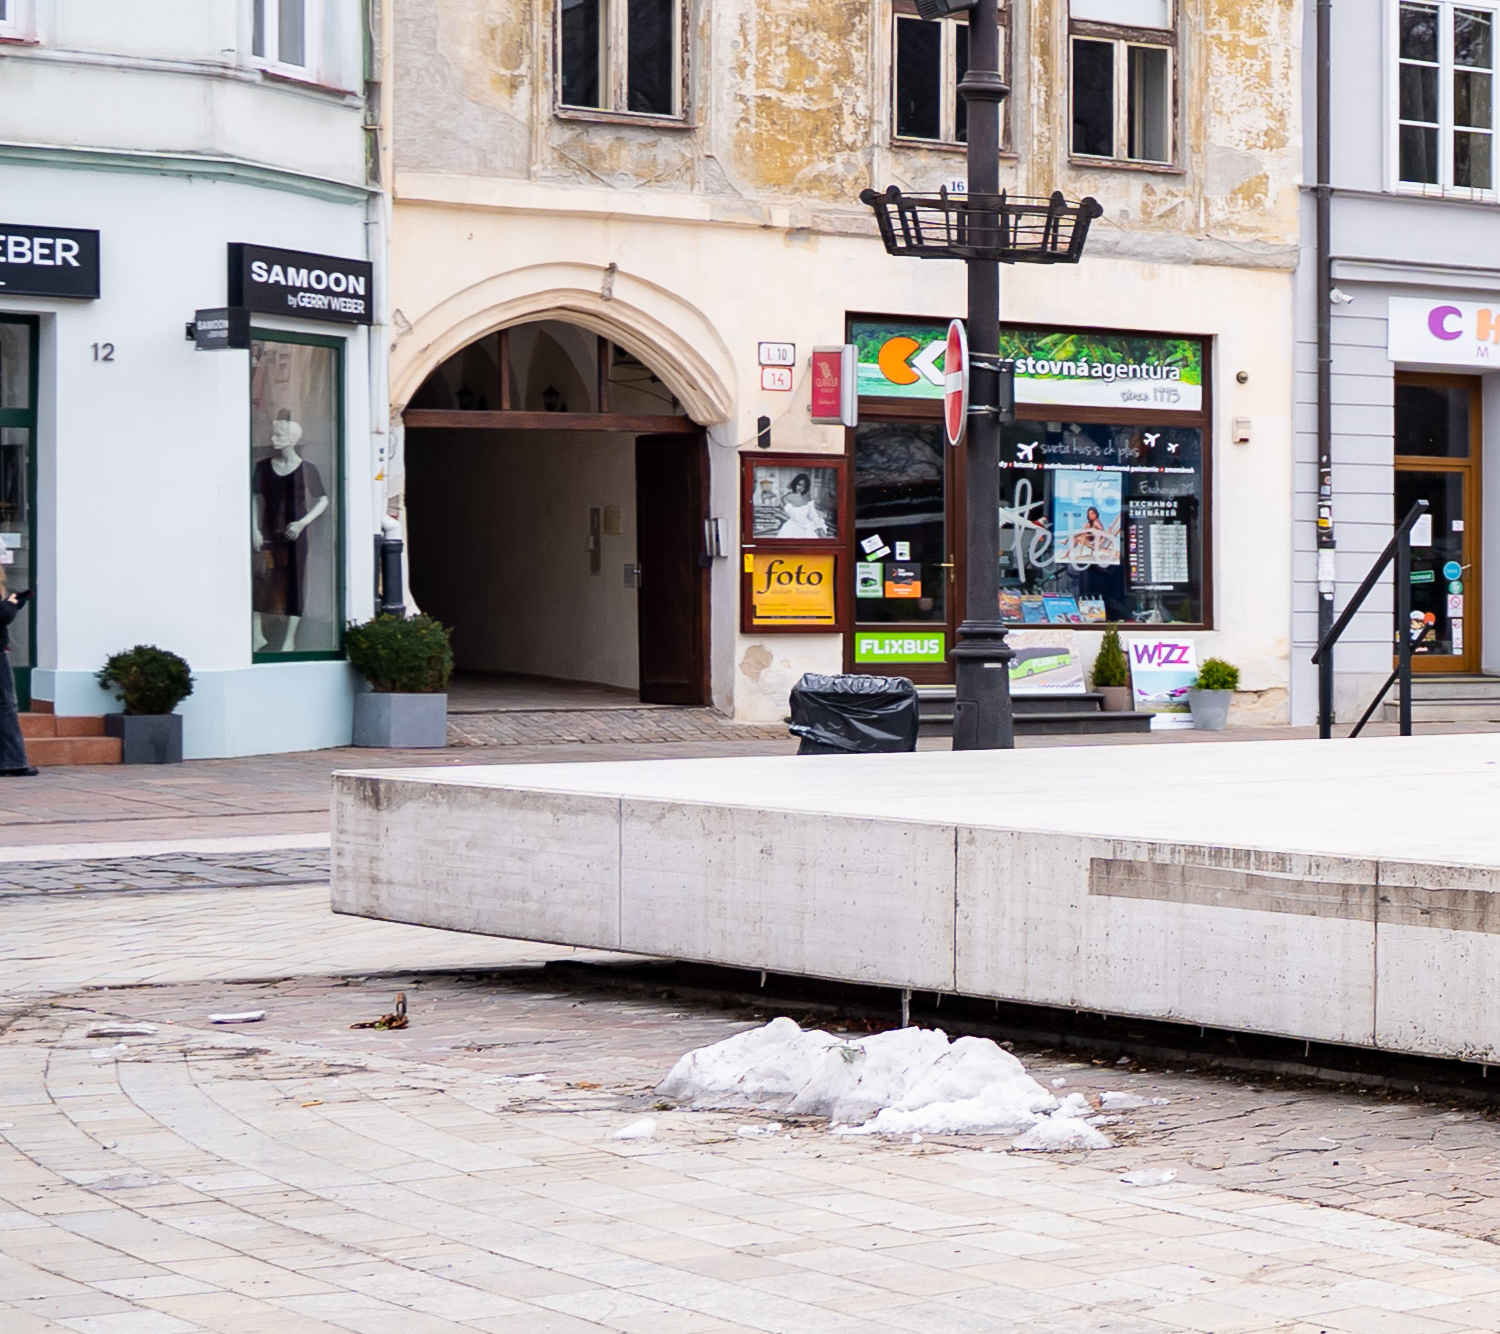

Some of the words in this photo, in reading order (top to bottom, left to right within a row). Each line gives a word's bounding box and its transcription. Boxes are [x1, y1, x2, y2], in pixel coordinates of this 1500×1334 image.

[251, 261, 366, 295] SAMOON
[288, 294, 297, 308] by
[298, 292, 329, 310] GERRY
[329, 297, 366, 315] WEBER
[91, 342, 115, 362] 12
[777, 348, 787, 361] 10
[771, 373, 784, 386] 14
[1000, 357, 1089, 377] stovná
[1092, 361, 1181, 382] agentúra
[1129, 500, 1178, 509] EXCHANGE
[757, 559, 823, 594] foto
